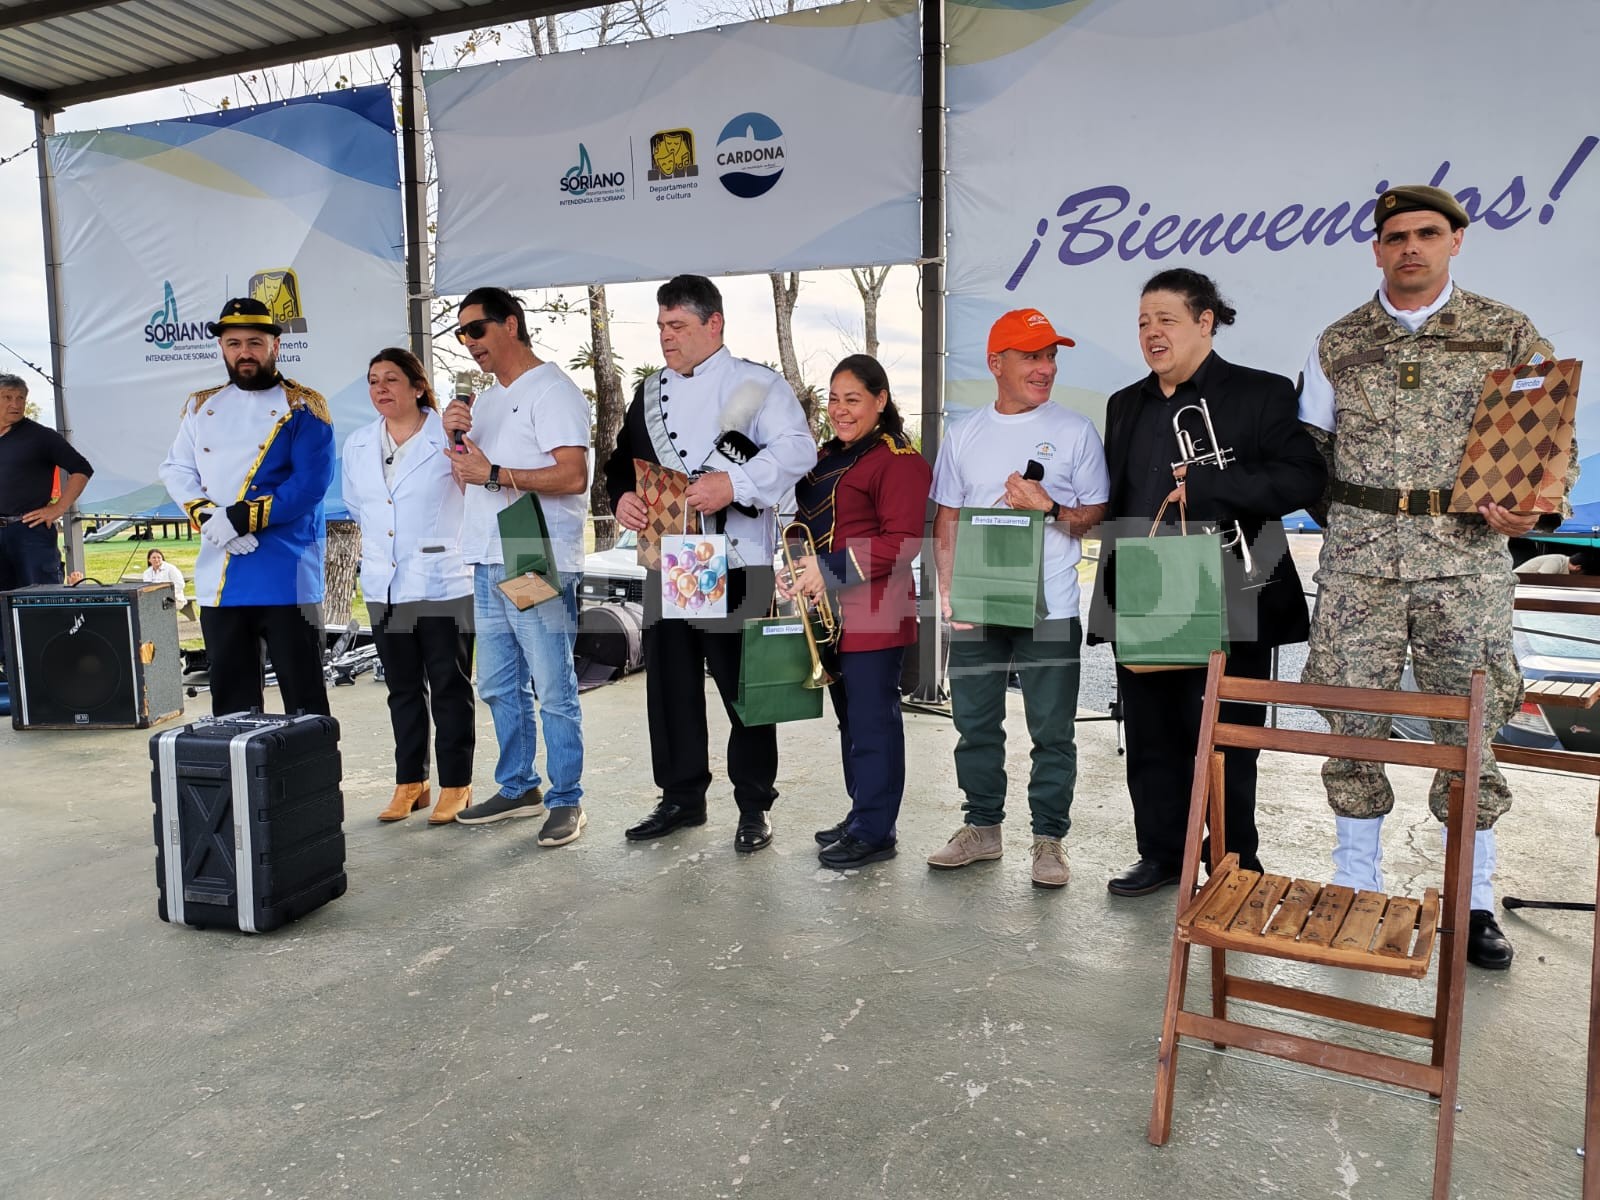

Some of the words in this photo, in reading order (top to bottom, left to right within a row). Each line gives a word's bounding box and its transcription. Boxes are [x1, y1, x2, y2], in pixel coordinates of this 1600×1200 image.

[716, 146, 785, 166] CARDONA
[560, 172, 625, 191] SORIANO
[649, 182, 698, 193] Departamento
[559, 197, 593, 206] INTENDENCIA
[602, 194, 626, 202] SORIANO
[655, 194, 665, 202] de
[665, 192, 692, 201] Cultura
[145, 353, 183, 363] INTENDENCIA
[183, 352, 192, 361] DE
[192, 351, 218, 361] SORIANO
